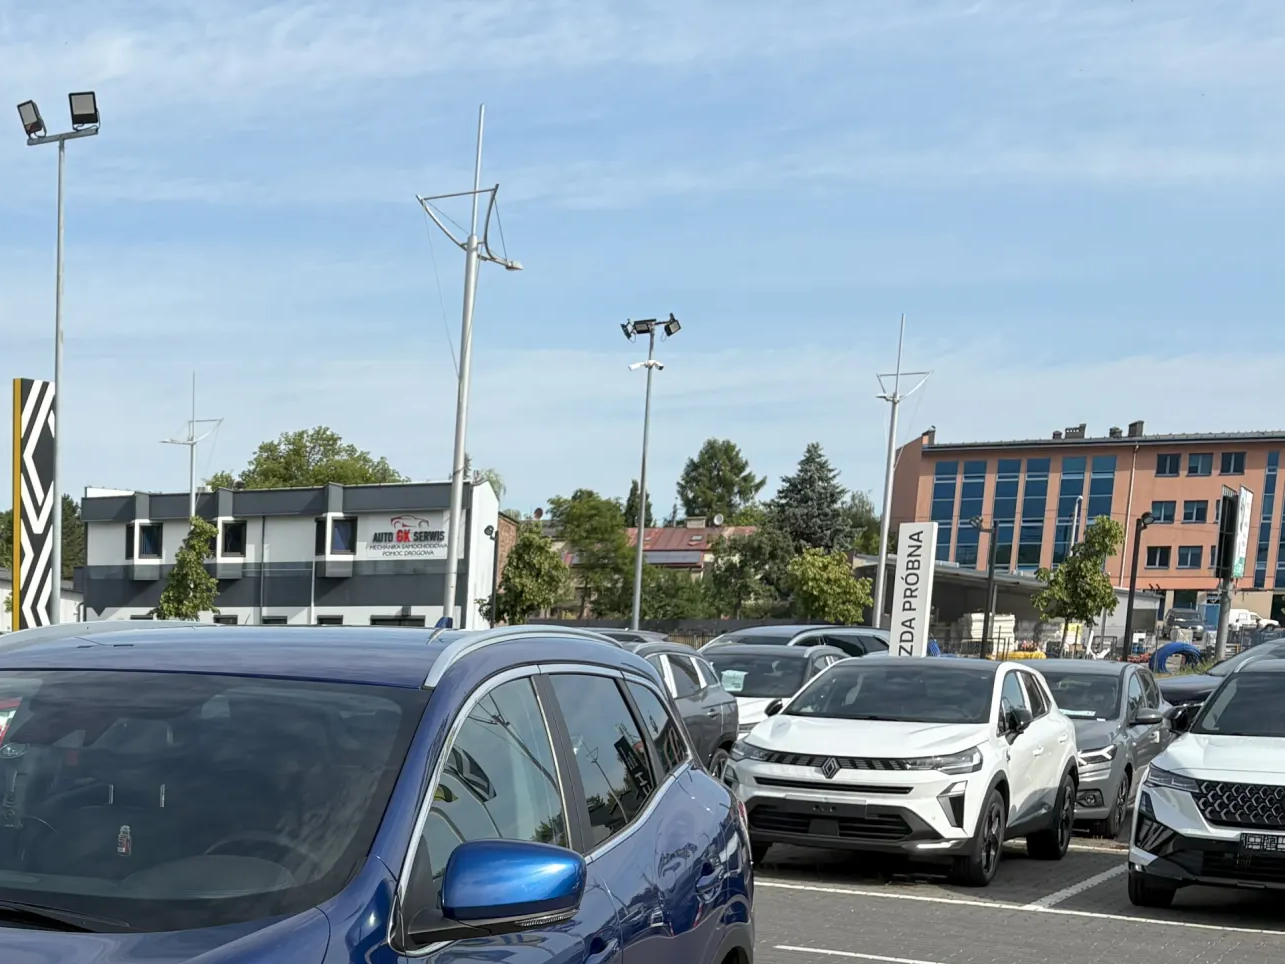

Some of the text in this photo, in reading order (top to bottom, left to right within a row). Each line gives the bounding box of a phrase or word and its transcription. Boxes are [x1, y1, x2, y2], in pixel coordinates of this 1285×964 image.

[372, 532, 394, 543] AUTO
[413, 530, 446, 542] SERWIS
[898, 530, 924, 657] ZDA PRÓBNA
